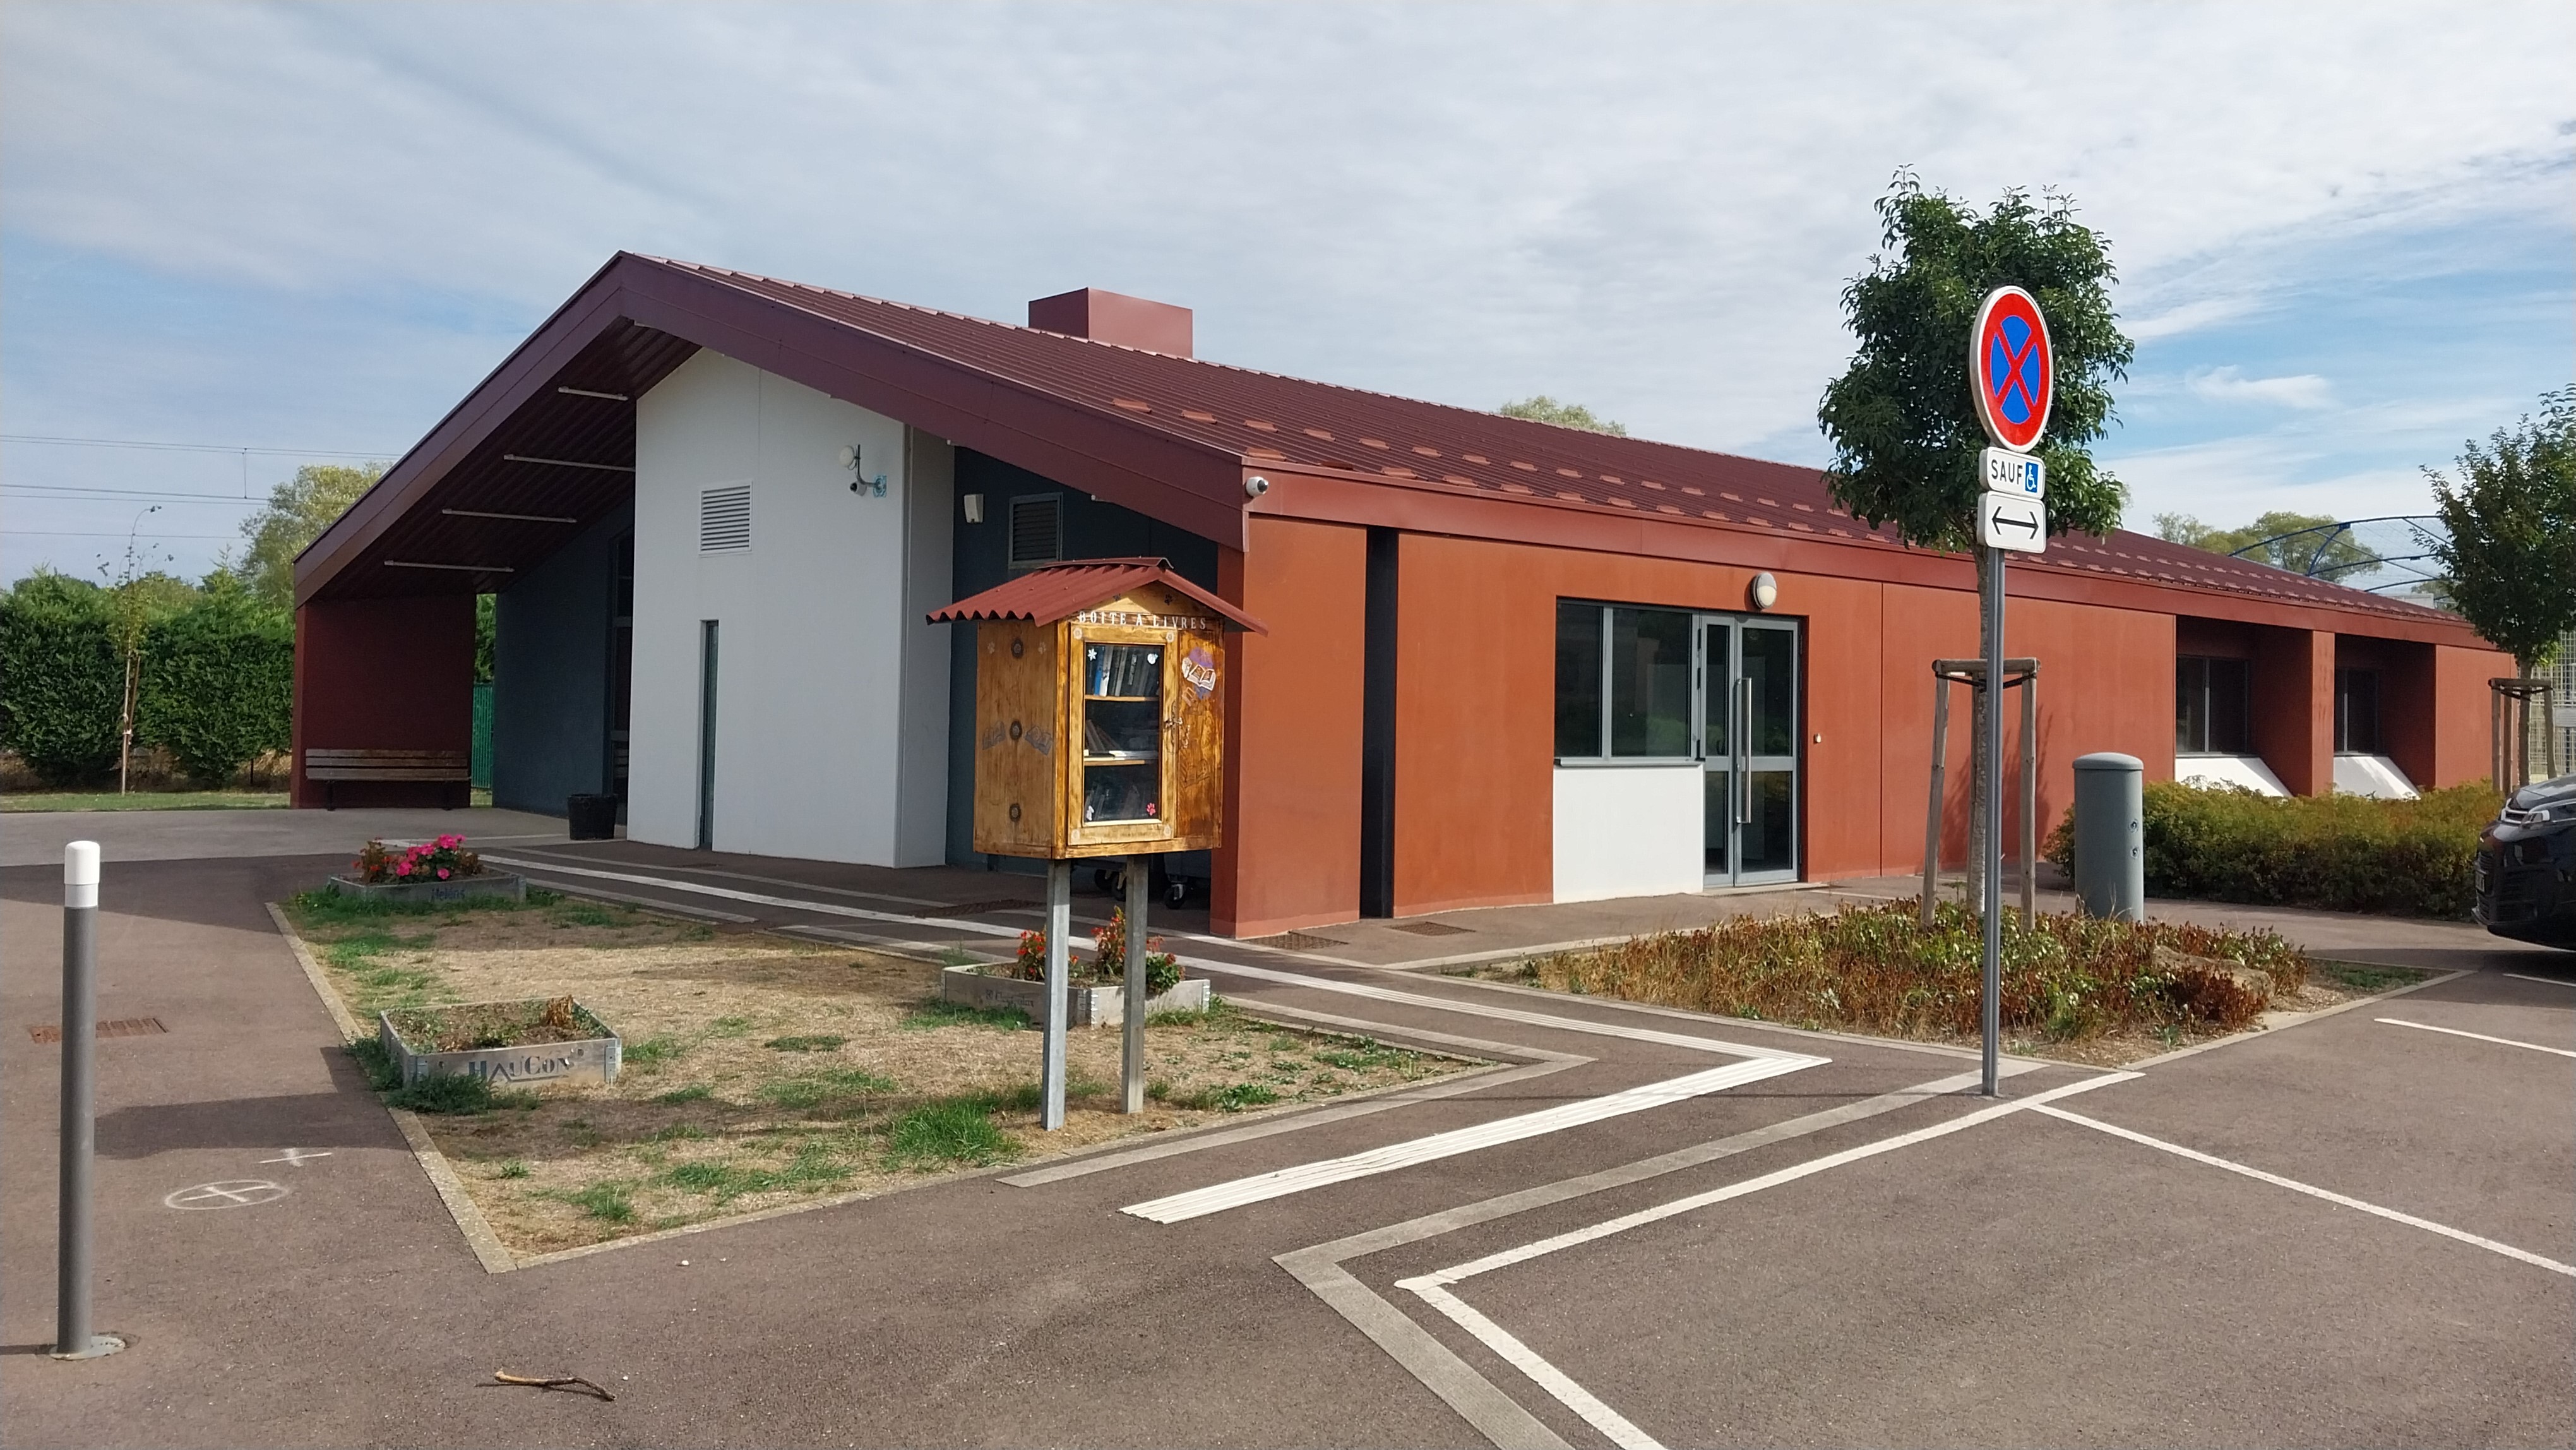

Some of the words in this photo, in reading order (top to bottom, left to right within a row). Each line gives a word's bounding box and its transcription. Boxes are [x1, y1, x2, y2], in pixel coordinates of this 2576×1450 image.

[1991, 458, 2023, 485] SAUF
[1078, 611, 1126, 625] BOITE
[1136, 613, 1143, 626] A
[1153, 614, 1206, 630] LIVRES
